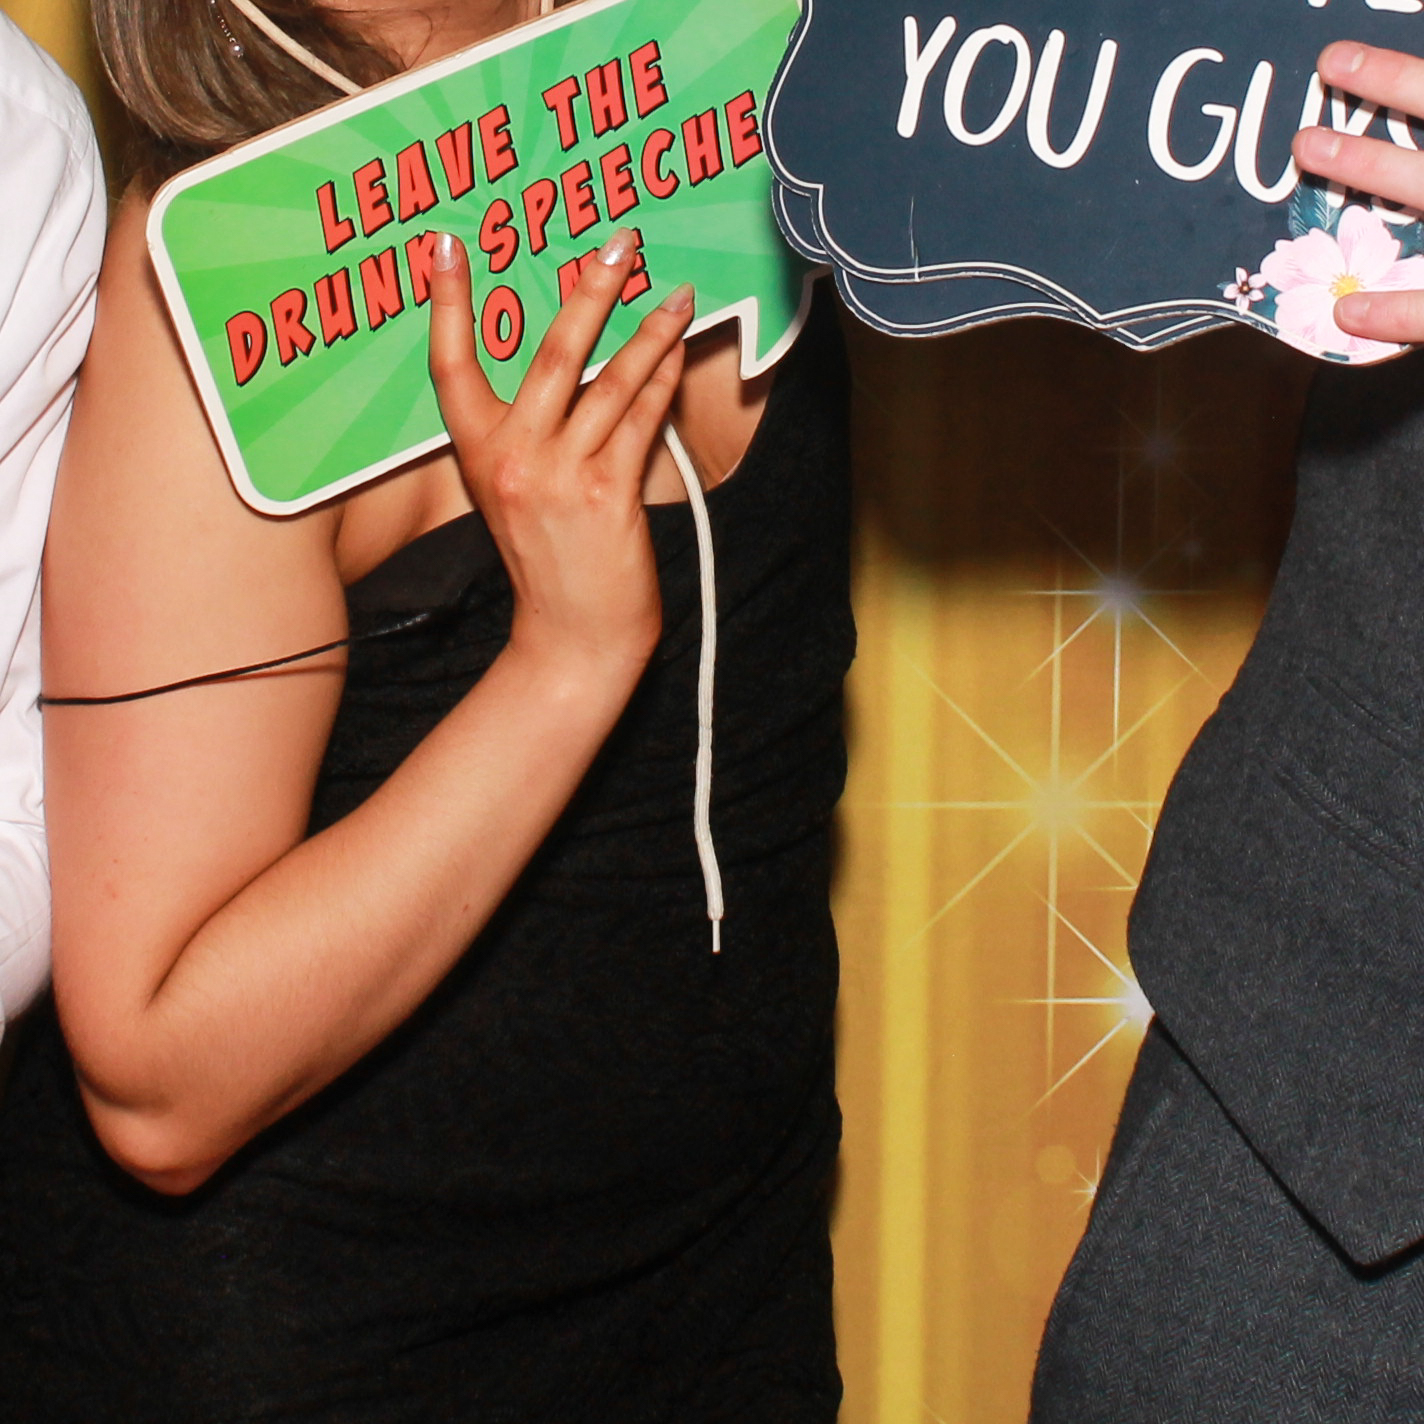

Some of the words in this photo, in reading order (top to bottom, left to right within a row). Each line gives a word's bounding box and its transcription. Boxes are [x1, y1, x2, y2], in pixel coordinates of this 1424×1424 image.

[315, 104, 518, 254] LEAVE
[541, 40, 668, 152] THE
[478, 90, 764, 274] SPEECHE
[896, 15, 1117, 168] YOU
